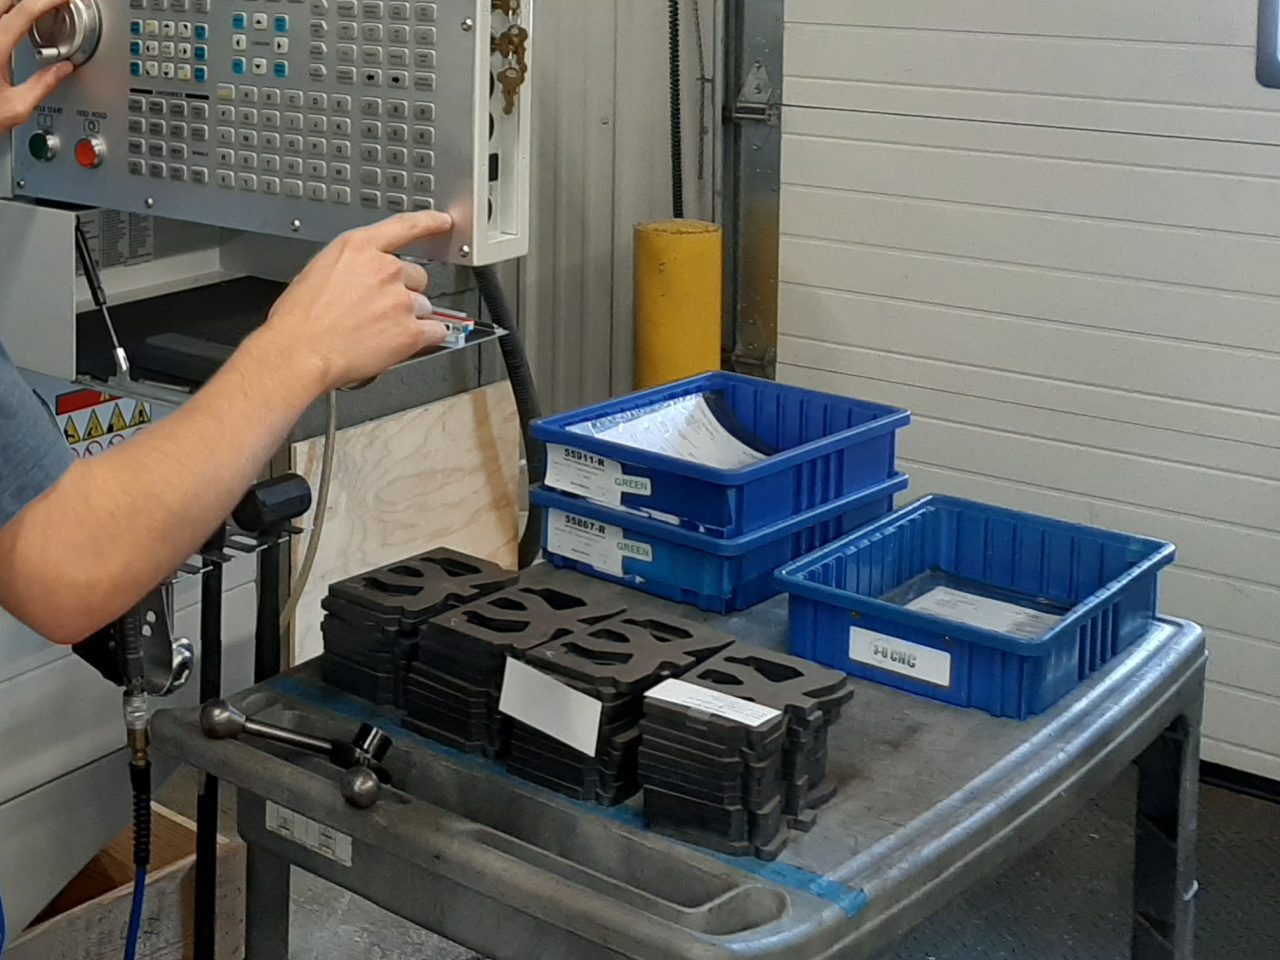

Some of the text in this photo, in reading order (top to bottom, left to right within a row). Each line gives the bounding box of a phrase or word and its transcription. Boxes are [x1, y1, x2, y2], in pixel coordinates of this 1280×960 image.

[564, 448, 605, 467] 55911-R
[614, 477, 648, 491] GREEN
[565, 515, 606, 534] 55867-R
[616, 542, 649, 556] GREEN
